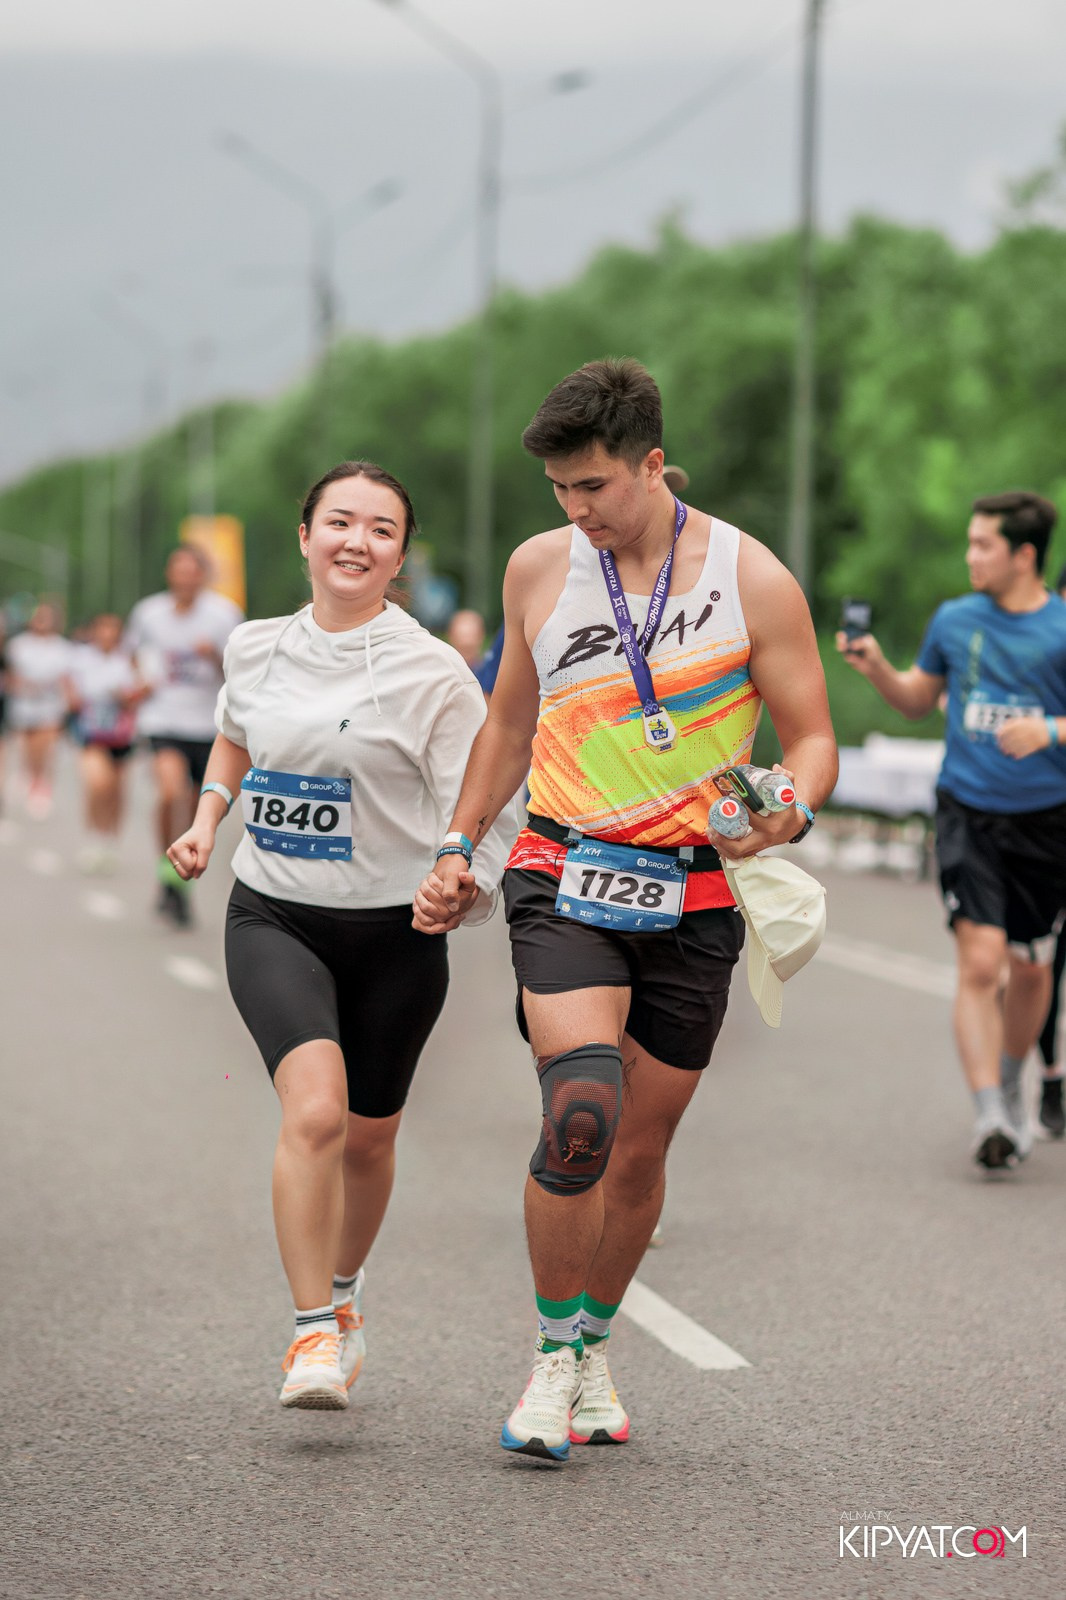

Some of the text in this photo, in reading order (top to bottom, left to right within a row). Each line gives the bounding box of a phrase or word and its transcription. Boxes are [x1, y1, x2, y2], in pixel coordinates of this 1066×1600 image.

[604, 557, 619, 591] JULDYZAI
[644, 595, 663, 642] ДОБРЫМ
[625, 643, 637, 666] GROUP
[254, 775, 269, 784] KM
[252, 796, 340, 833] 1840
[583, 847, 602, 857] KM
[647, 861, 671, 870] GROUP
[579, 869, 666, 908] 1128
